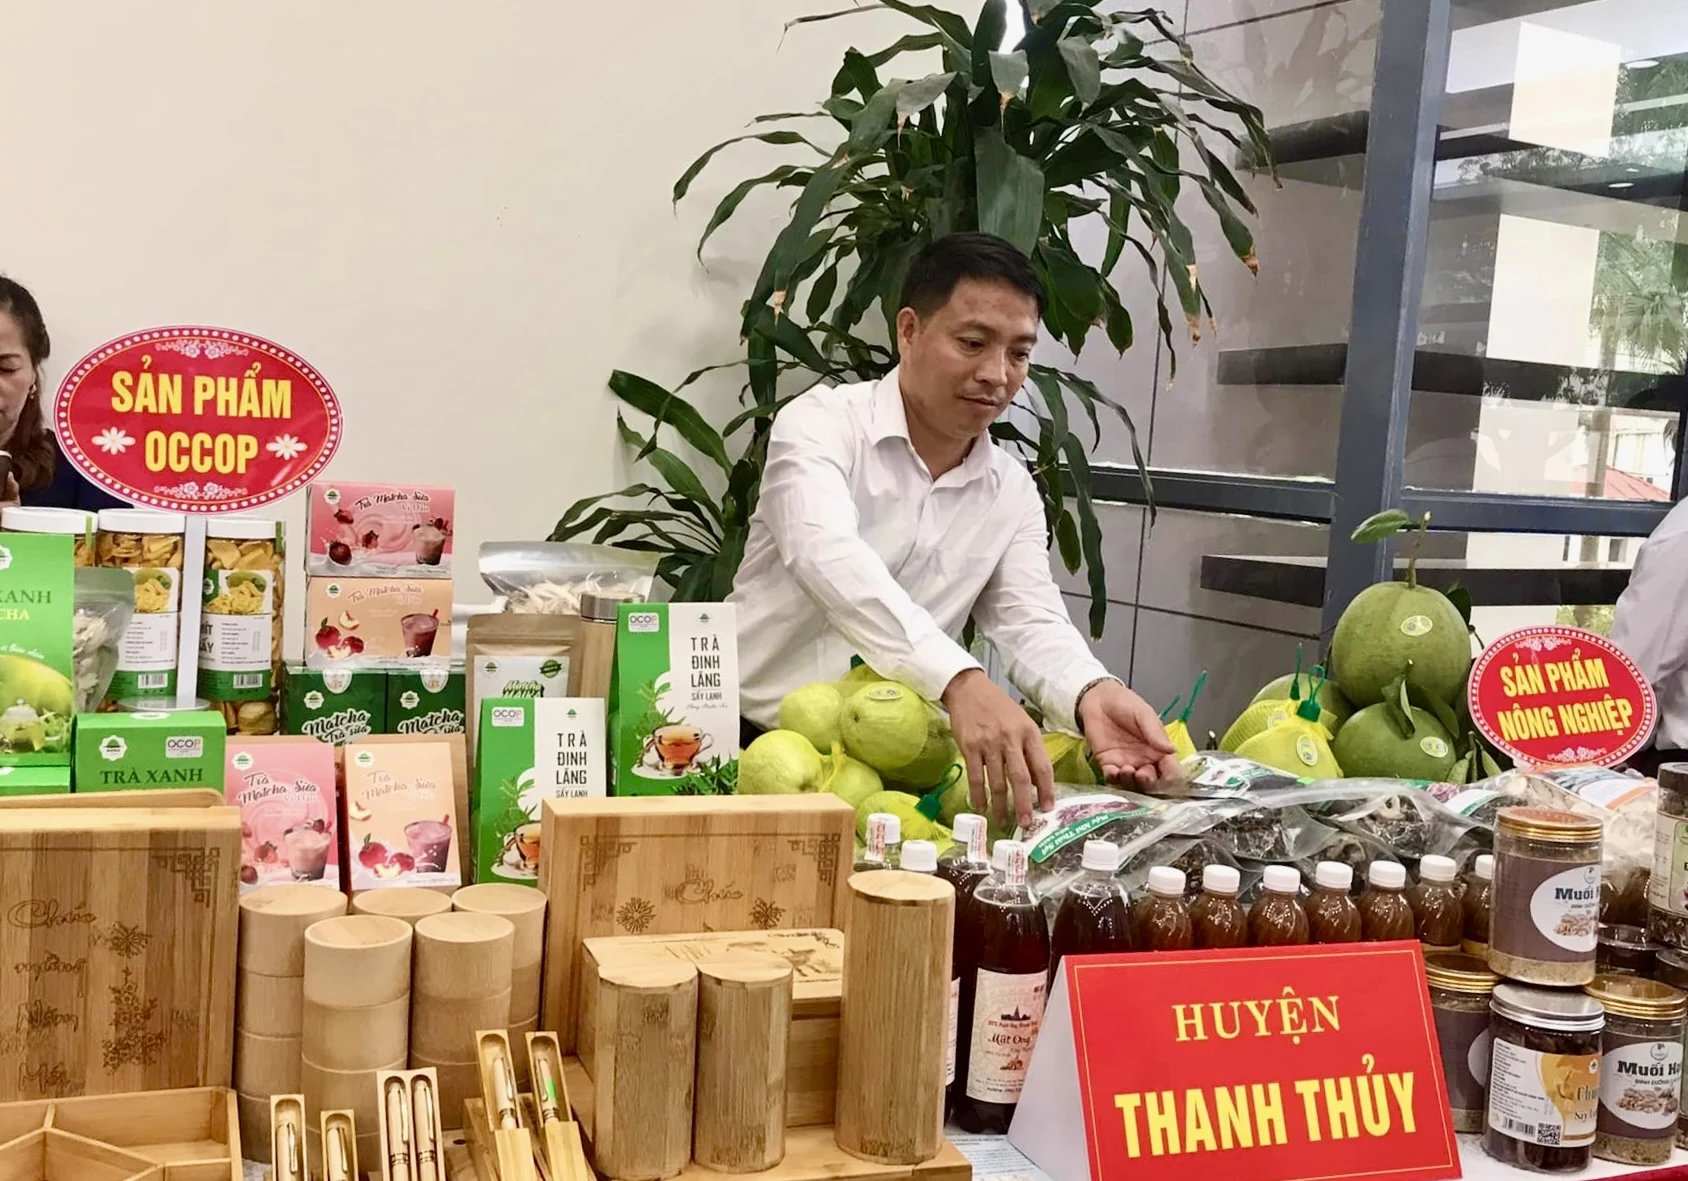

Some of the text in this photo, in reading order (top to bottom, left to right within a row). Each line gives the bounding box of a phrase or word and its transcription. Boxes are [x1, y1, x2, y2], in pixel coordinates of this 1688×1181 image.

[111, 355, 292, 419] SẢN PHẨM
[145, 430, 259, 474] OCCOP
[630, 615, 656, 624] OCOP
[691, 634, 719, 651] TRÀ
[692, 656, 720, 669] ĐINH
[691, 671, 721, 688] LĂNG
[1500, 648, 1610, 698] SẢN PHẨM
[400, 710, 460, 734] Matcha
[493, 709, 522, 718] OCOP
[1498, 693, 1633, 742] NÔNG NGHIỆP
[303, 711, 367, 735] Matcha
[167, 739, 201, 748] OCOP
[557, 730, 587, 748] TRÀ
[557, 751, 587, 766] ĐINH
[100, 767, 203, 784] TRÀ XANH
[556, 768, 587, 785] LĂNG
[1555, 885, 1594, 901] Muối
[1172, 986, 1340, 1044] HUYỆN
[1013, 1035, 1031, 1047] Ong
[1617, 1060, 1664, 1077] Muối
[1114, 1083, 1288, 1158] THANH
[1295, 1053, 1416, 1141] THỦY
